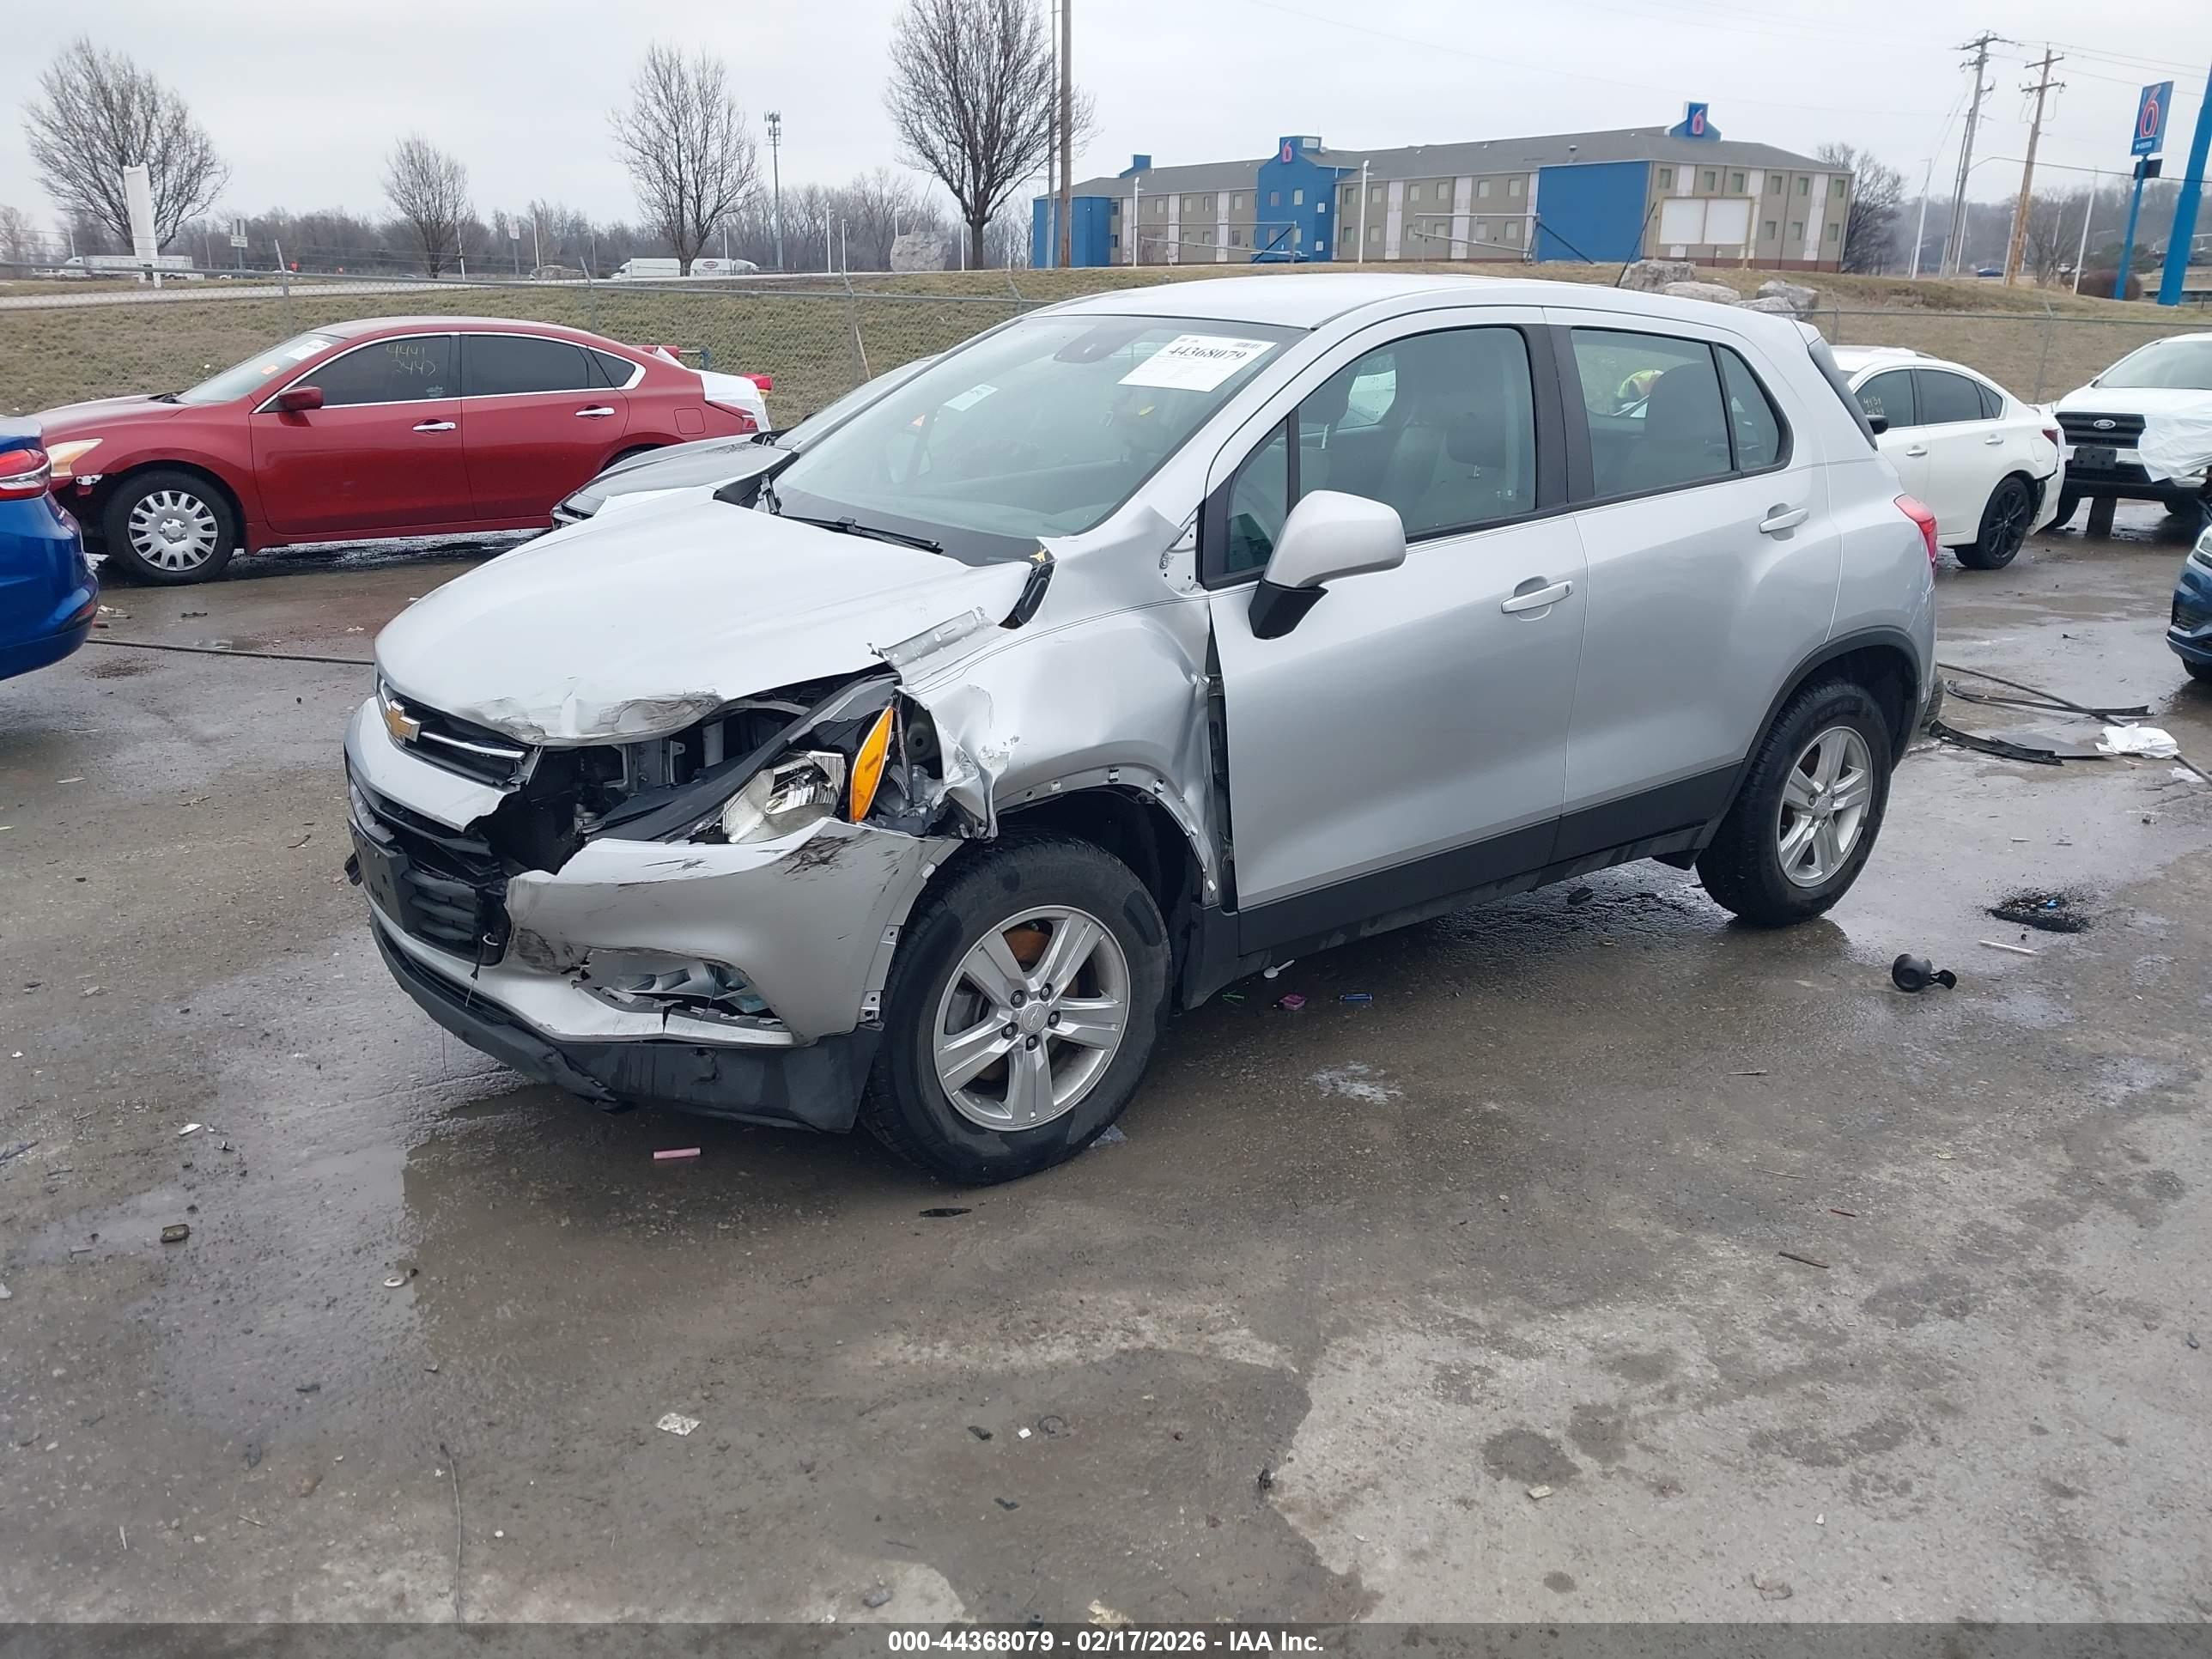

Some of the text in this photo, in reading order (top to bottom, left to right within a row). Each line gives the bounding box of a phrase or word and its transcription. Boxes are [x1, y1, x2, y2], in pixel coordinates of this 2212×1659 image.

[1692, 109, 1705, 135] 6
[2140, 85, 2160, 137] 6
[1283, 140, 1292, 162] 6
[1168, 345, 1248, 360] 44368079
